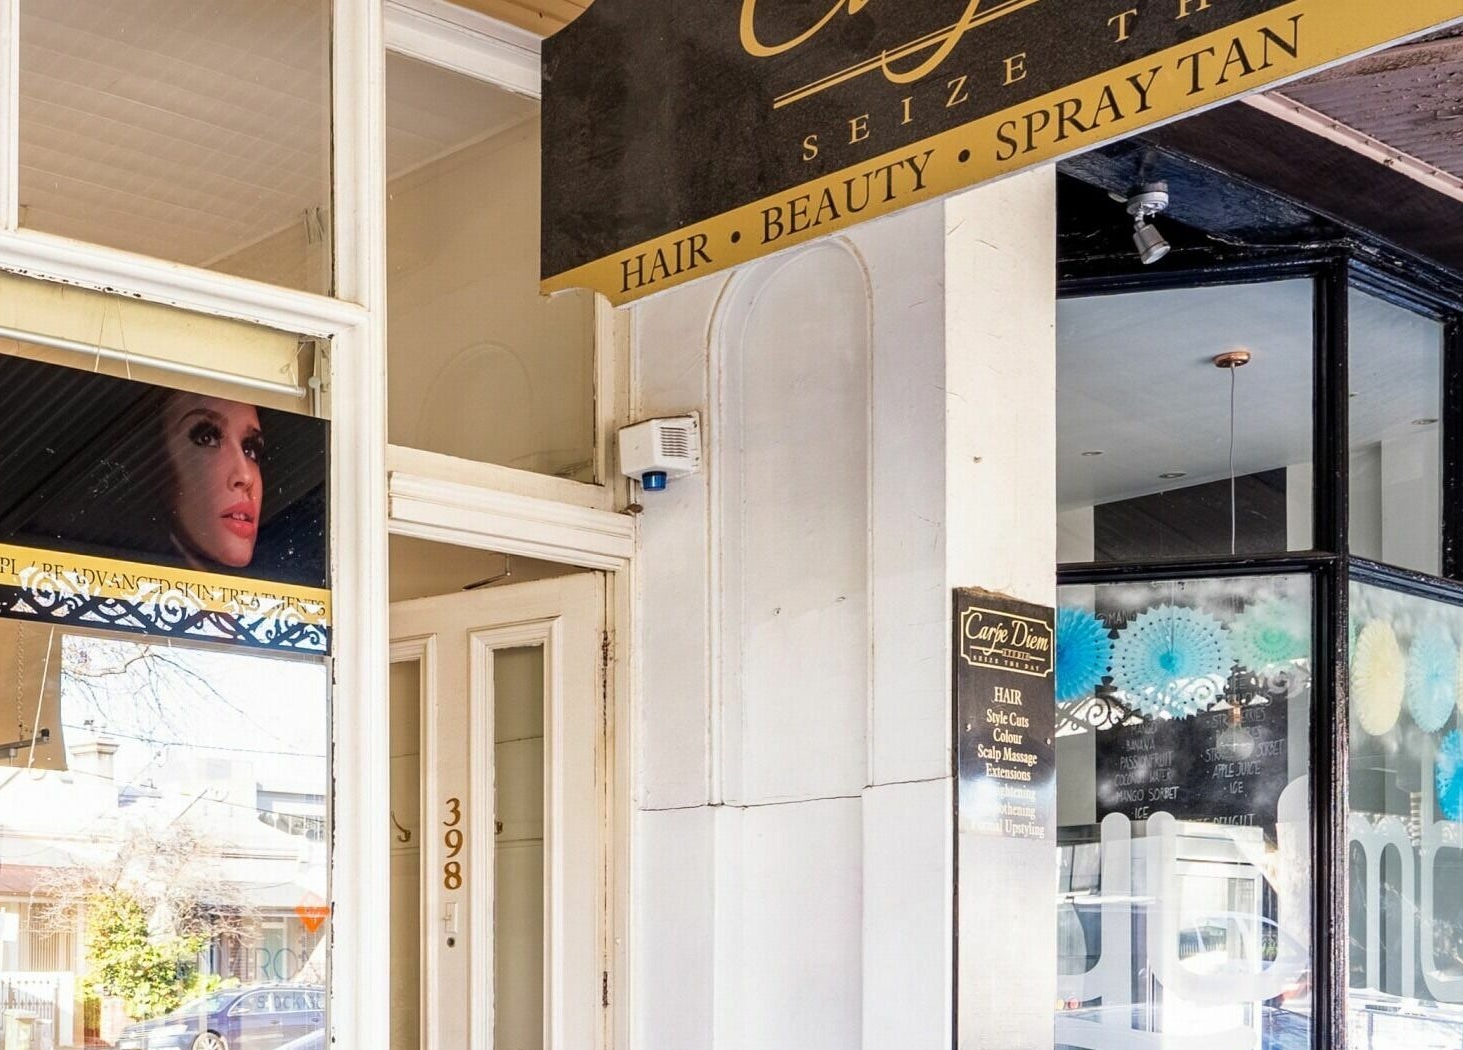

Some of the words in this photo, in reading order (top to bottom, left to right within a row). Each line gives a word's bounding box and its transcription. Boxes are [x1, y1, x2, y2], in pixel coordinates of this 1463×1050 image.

[802, 52, 1027, 161] SEIZE
[620, 231, 713, 293] HAIR
[760, 149, 937, 244] BEAUTY
[995, 66, 1164, 161] SPRAY
[1178, 14, 1306, 95] TAN
[175, 581, 214, 601] SKIN
[965, 612, 1009, 656] Carpe
[1010, 620, 1049, 651] Diem
[994, 686, 1022, 706] HAIR
[986, 708, 1009, 726] Style
[1009, 712, 1029, 728] Cuts
[993, 727, 1023, 745] Colour
[977, 743, 1001, 763] Scalp
[1002, 747, 1038, 767] Massage
[985, 762, 1031, 781] Extensions
[1005, 819, 1045, 839] Upstyling
[443, 798, 463, 890] 398
